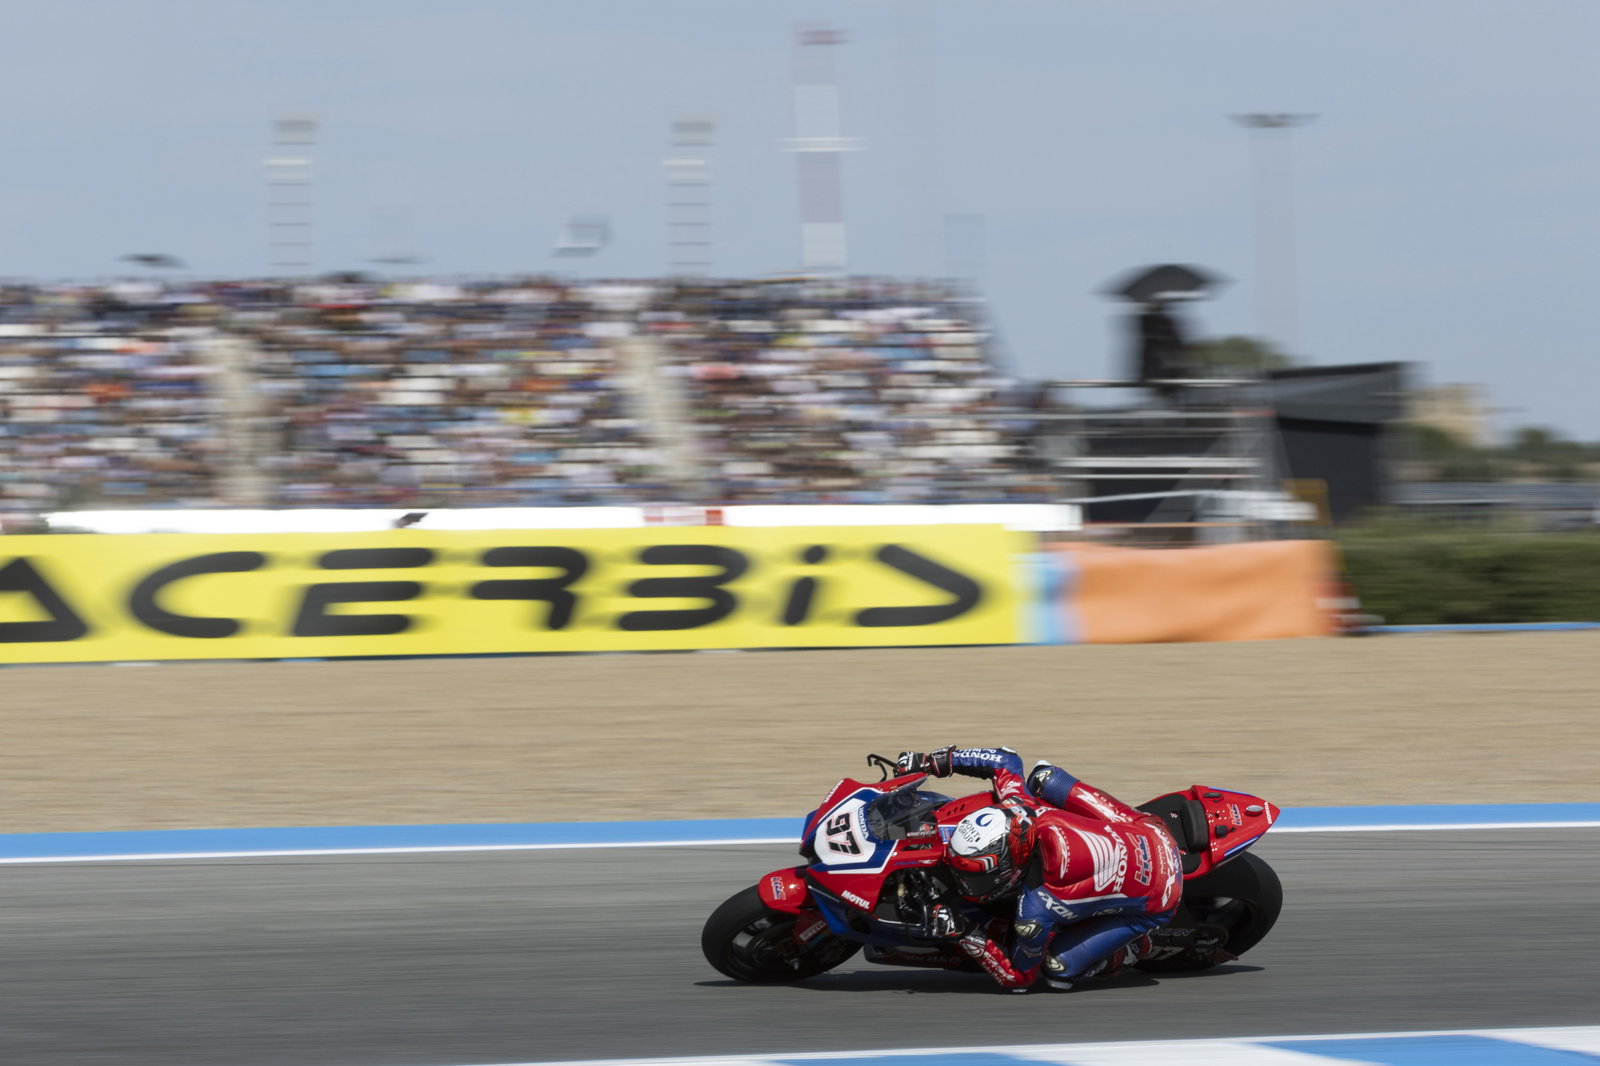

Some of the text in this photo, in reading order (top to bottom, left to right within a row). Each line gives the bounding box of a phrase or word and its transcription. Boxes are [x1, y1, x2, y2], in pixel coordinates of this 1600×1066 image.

[952, 751, 1003, 763] HONDA
[858, 806, 869, 840] HONDA
[1264, 801, 1272, 824] HONDA
[826, 811, 863, 856] 97
[958, 825, 974, 843] GRUP
[1103, 825, 1128, 893] HONDA
[841, 890, 871, 910] MOTUL
